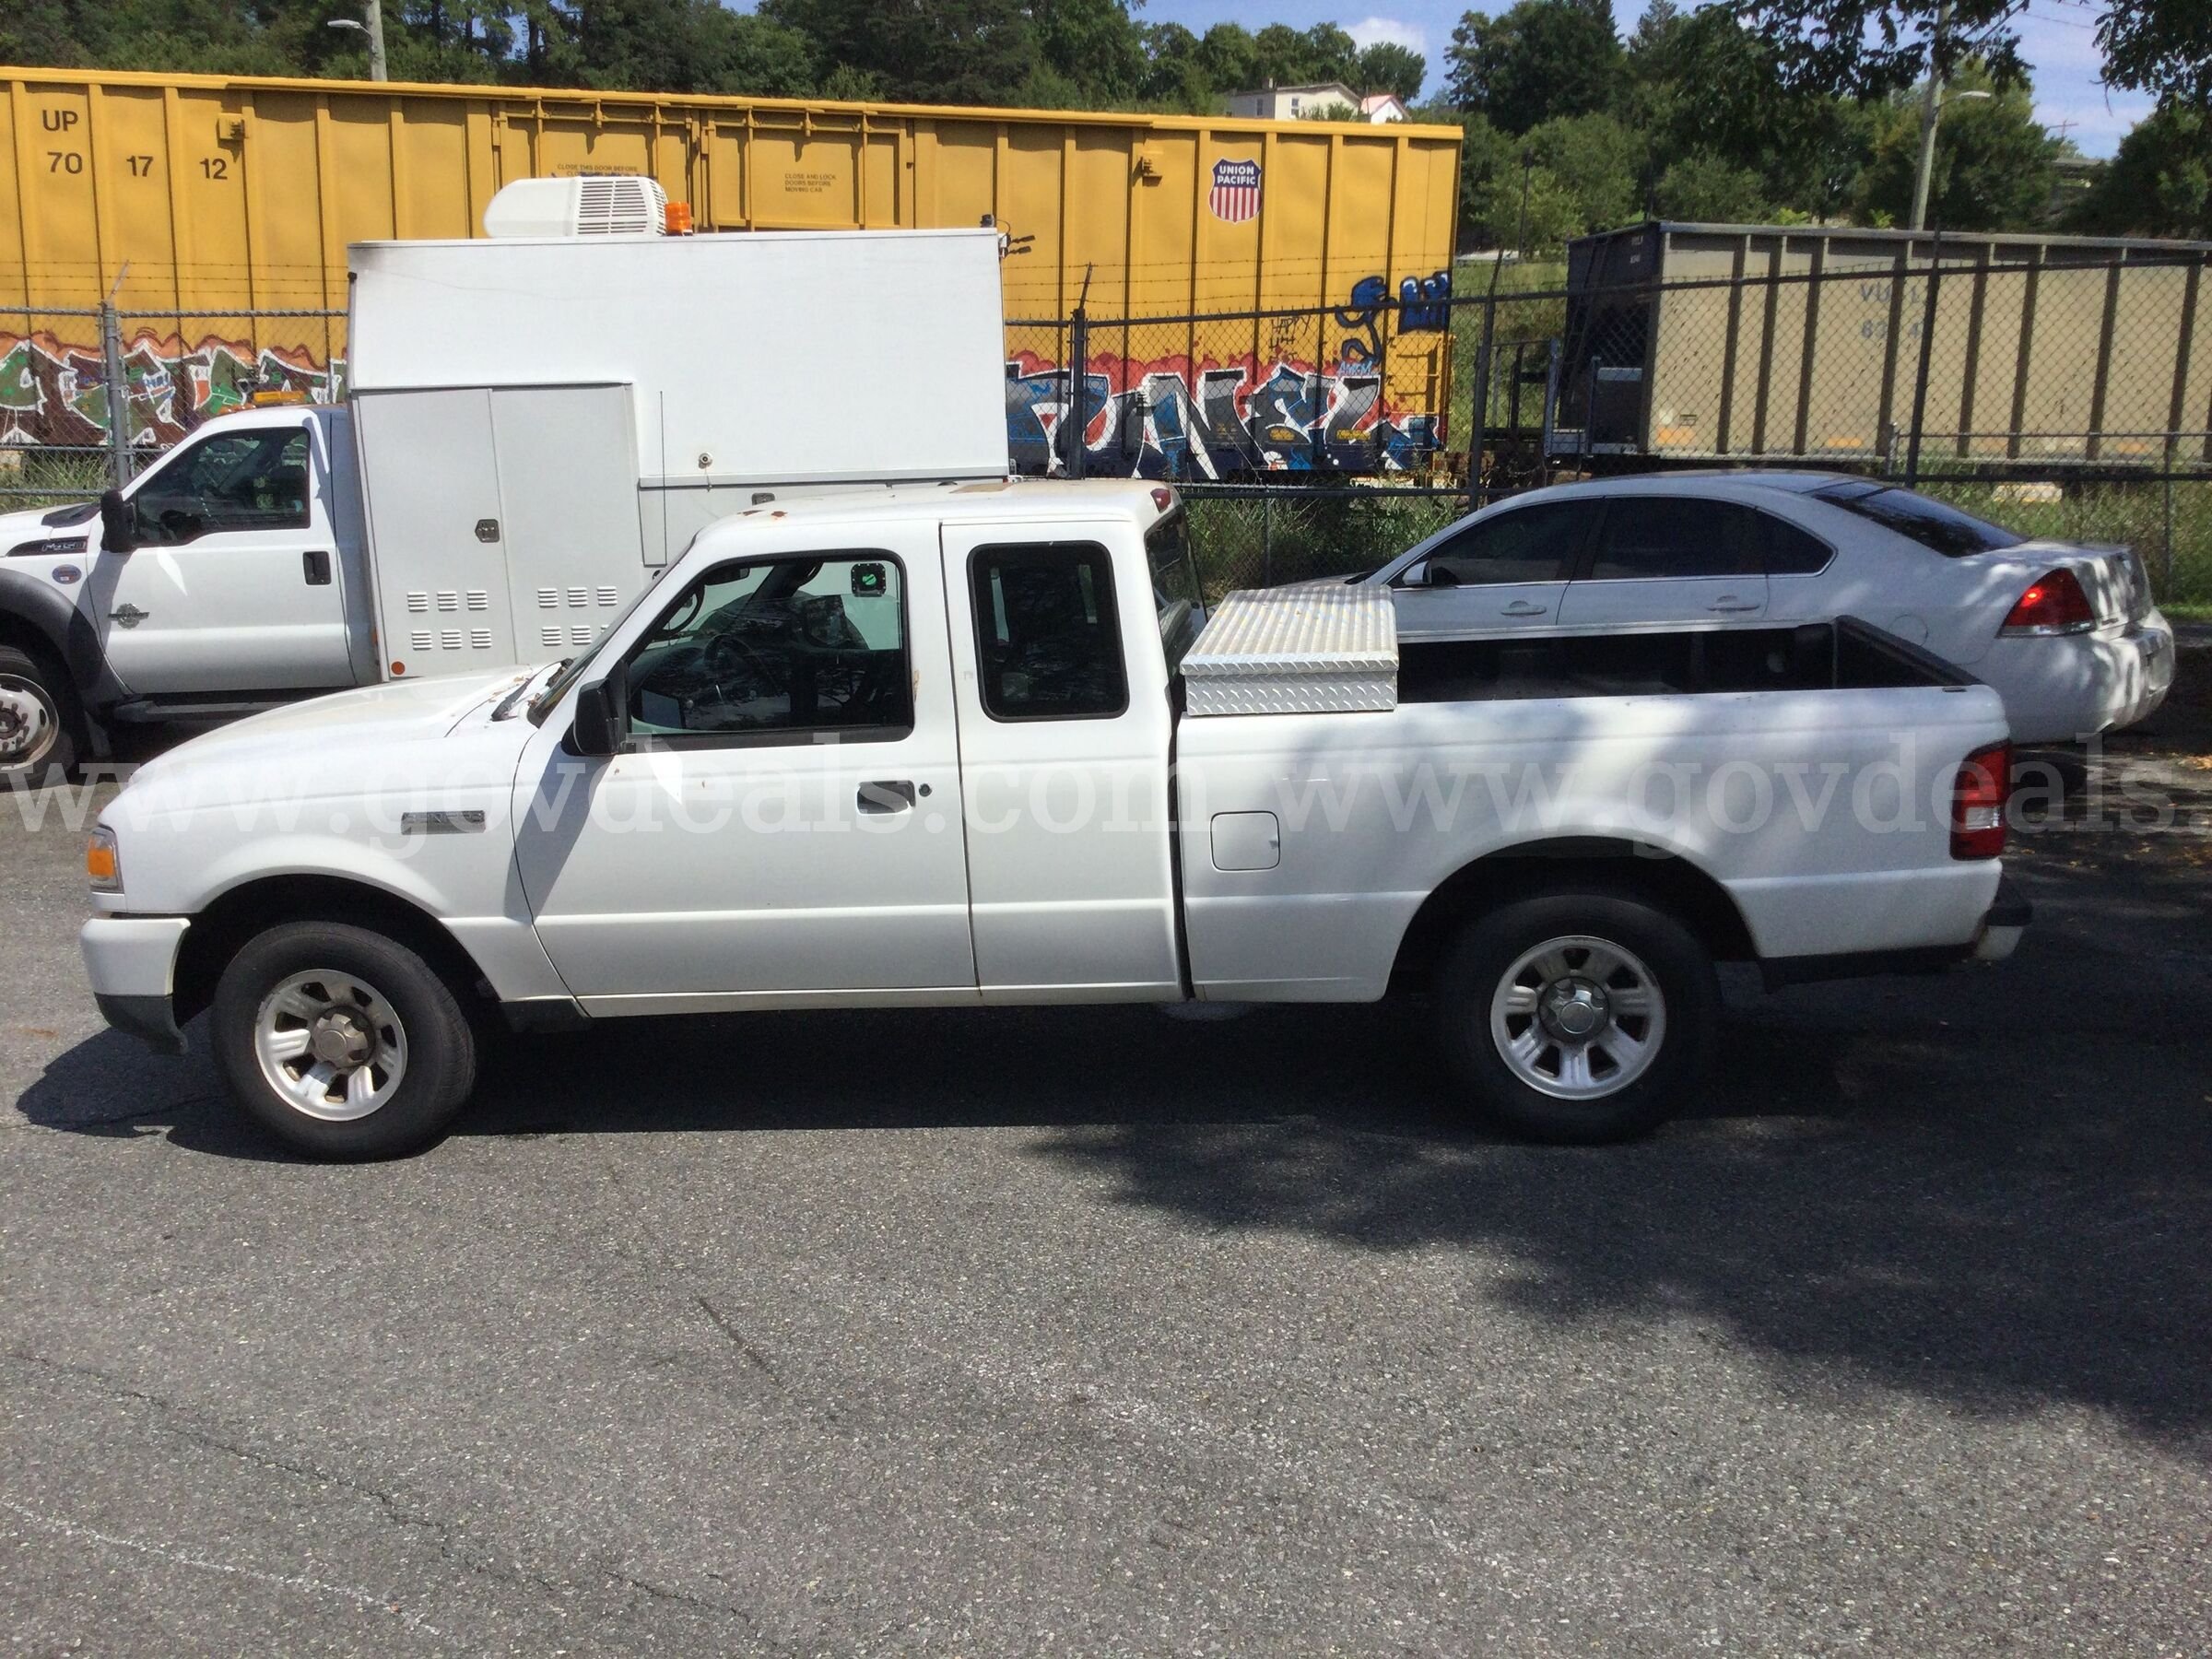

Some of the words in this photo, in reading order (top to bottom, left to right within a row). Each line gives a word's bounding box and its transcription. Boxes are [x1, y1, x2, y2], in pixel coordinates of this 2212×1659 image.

[42, 110, 78, 132] UP
[47, 152, 83, 174] 70
[126, 156, 154, 177] 17
[199, 158, 229, 180] 12
[1219, 166, 1254, 176] UNION
[1217, 175, 1256, 185] PACIFIC
